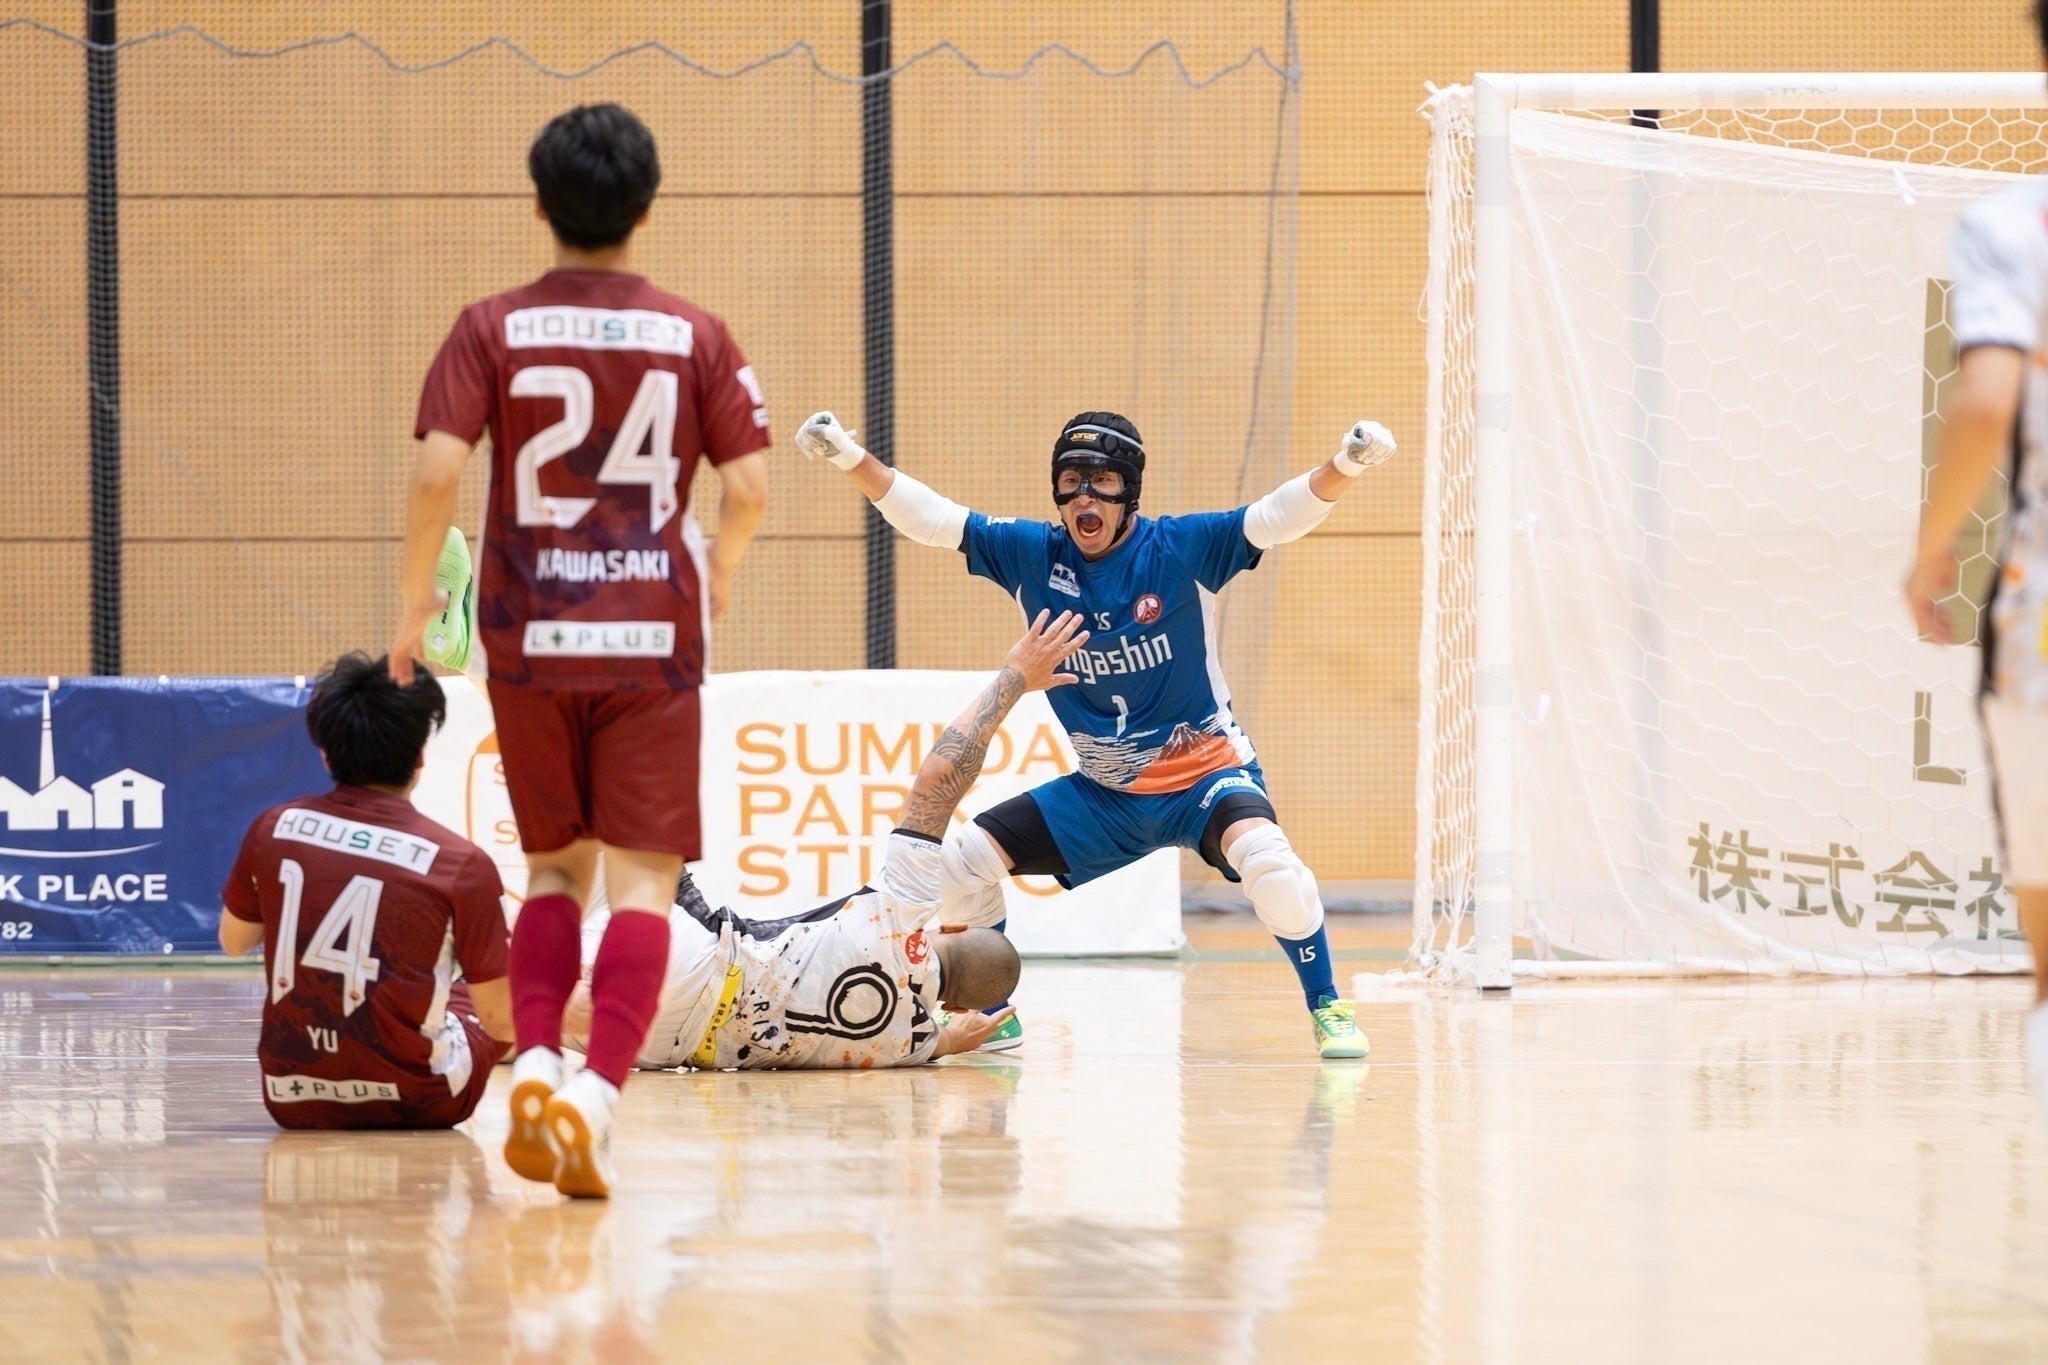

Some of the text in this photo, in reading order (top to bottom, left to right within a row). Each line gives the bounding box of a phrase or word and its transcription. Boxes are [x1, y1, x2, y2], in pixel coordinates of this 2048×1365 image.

[513, 314, 684, 346] HOUSET
[509, 365, 681, 534] 24
[536, 548, 669, 581] KAWASAKI
[735, 722, 1072, 776] SUMDA
[279, 814, 430, 864] HOUSET
[38, 874, 168, 901] PLACE
[1688, 821, 2030, 941] 株式会社
[0, 921, 33, 940] 82
[272, 858, 384, 1018] 14
[306, 1025, 338, 1054] YU
